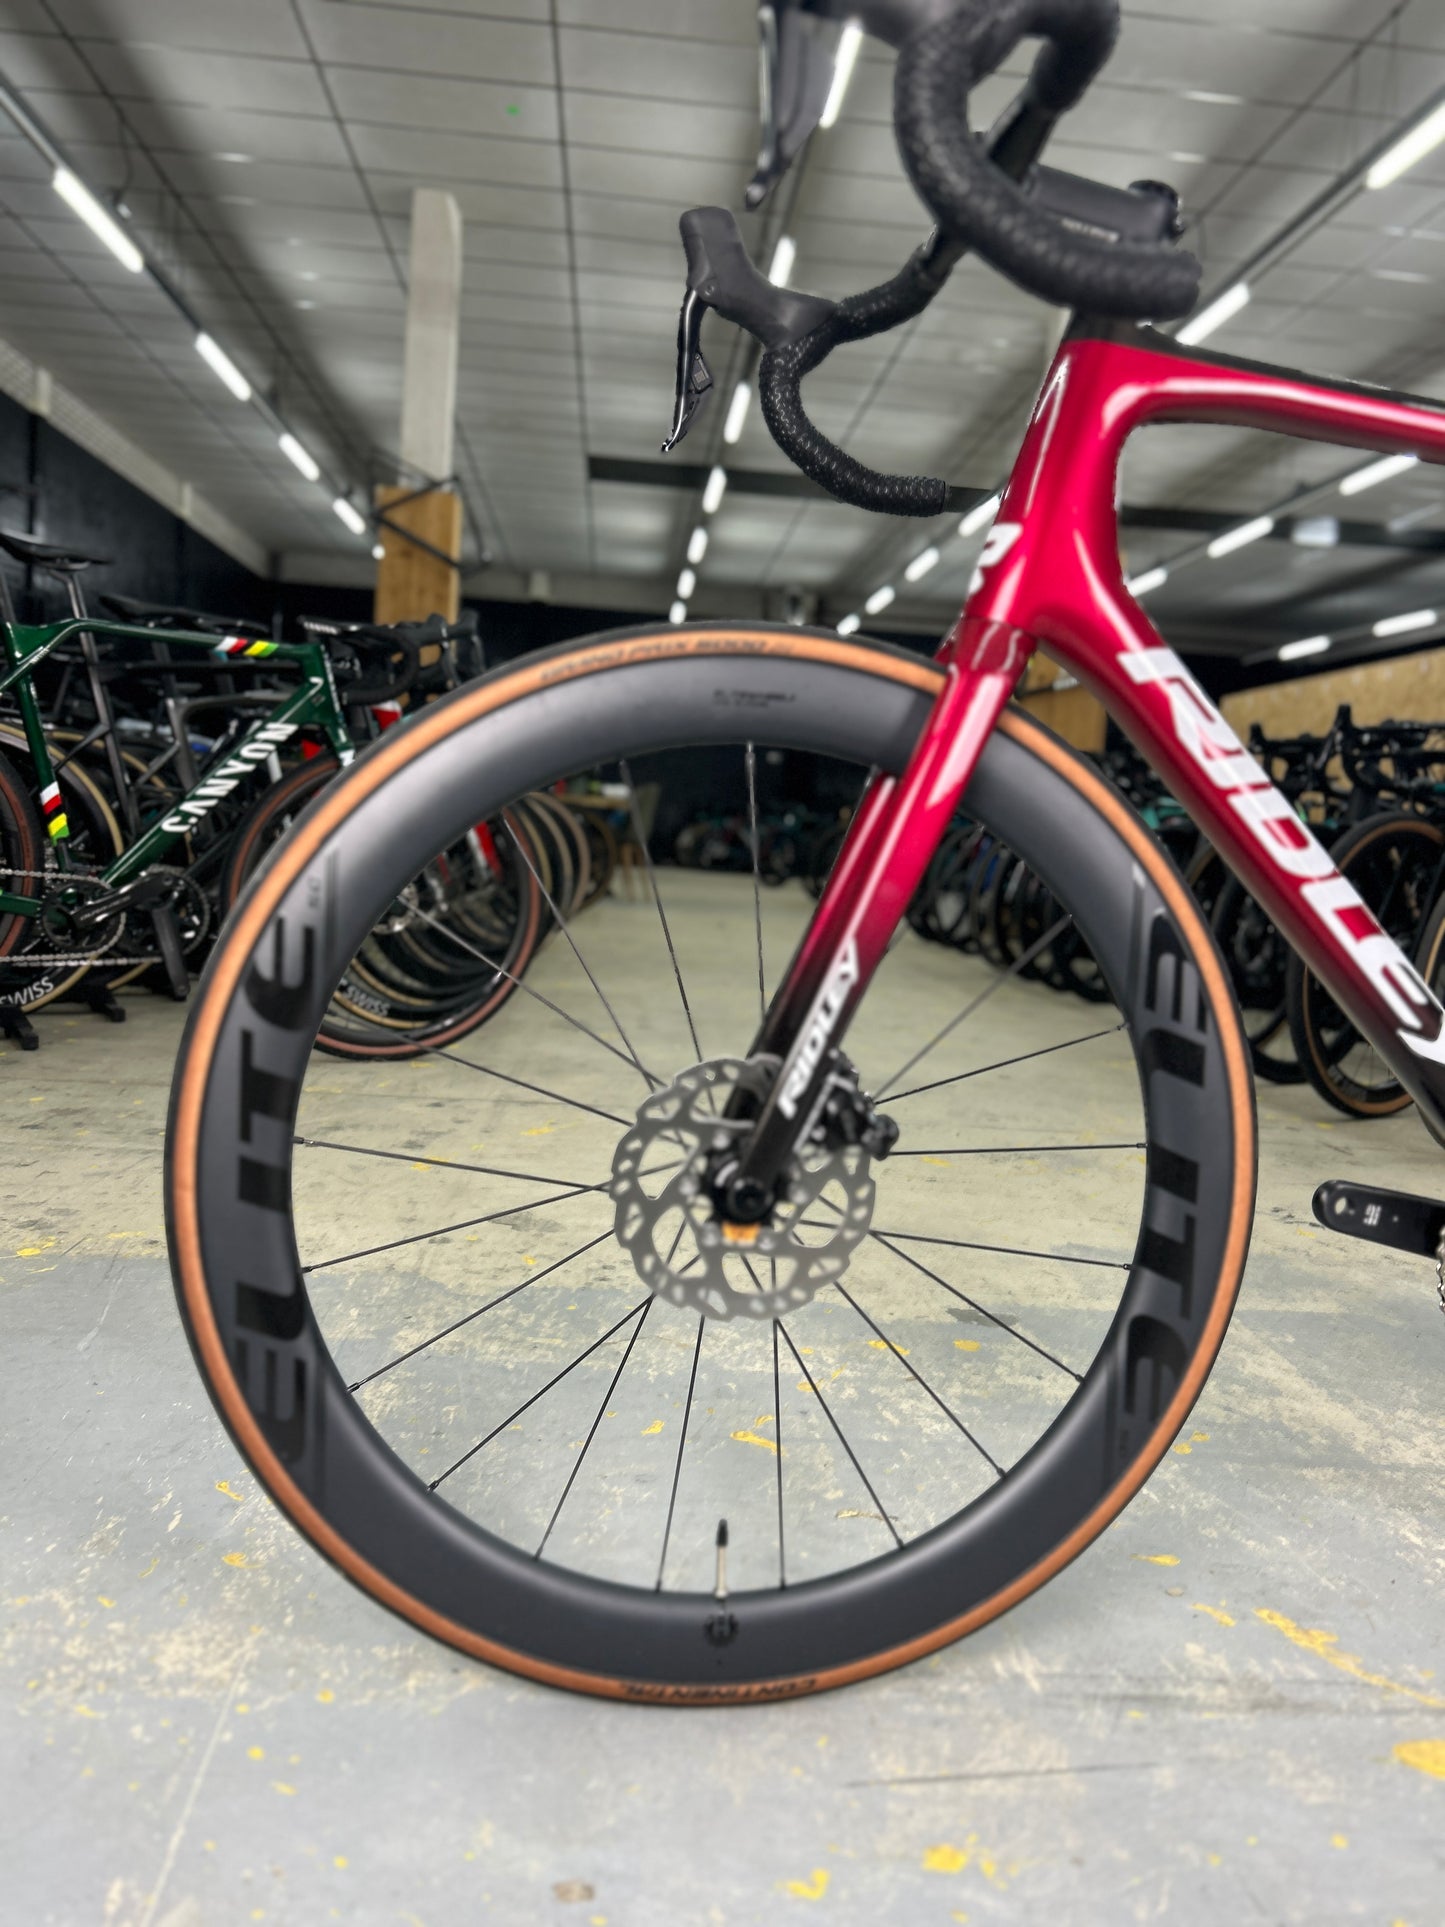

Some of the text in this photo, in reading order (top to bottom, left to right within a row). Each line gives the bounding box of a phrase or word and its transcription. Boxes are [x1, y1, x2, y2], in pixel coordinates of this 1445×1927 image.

[160, 721, 299, 833] CANYON
[236, 913, 316, 1463] ELITE
[777, 934, 860, 1120] RIDLEY
[1124, 911, 1207, 1424] ELITE
